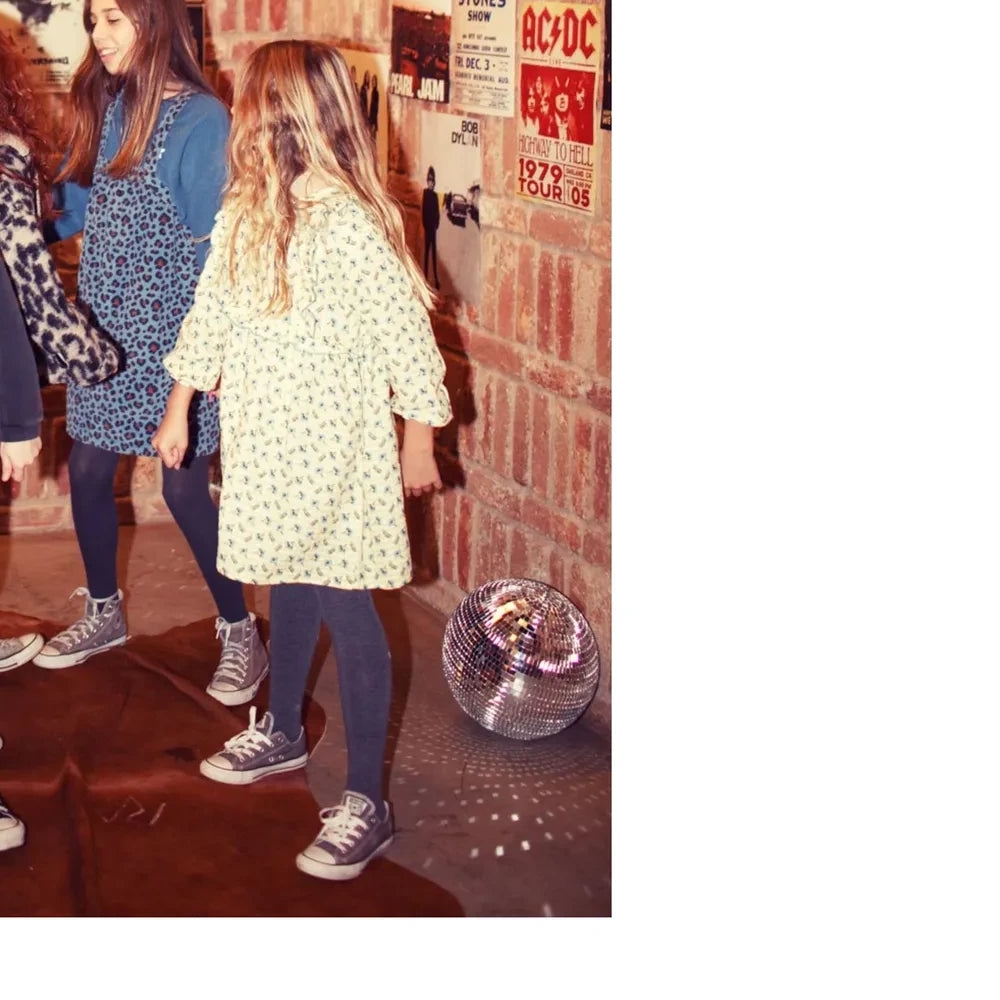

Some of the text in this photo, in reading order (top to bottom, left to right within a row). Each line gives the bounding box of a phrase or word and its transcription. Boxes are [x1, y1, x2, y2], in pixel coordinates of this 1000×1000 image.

[467, 10, 492, 23] SHOW
[484, 60, 490, 71] 3
[417, 77, 444, 102] JAM
[462, 121, 478, 134] BOB
[452, 132, 478, 147] DYLN
[519, 134, 593, 167] HIGHWAY TO HELL
[519, 158, 562, 185] 1979
[519, 177, 562, 200] TOUR
[571, 186, 590, 207] 05
